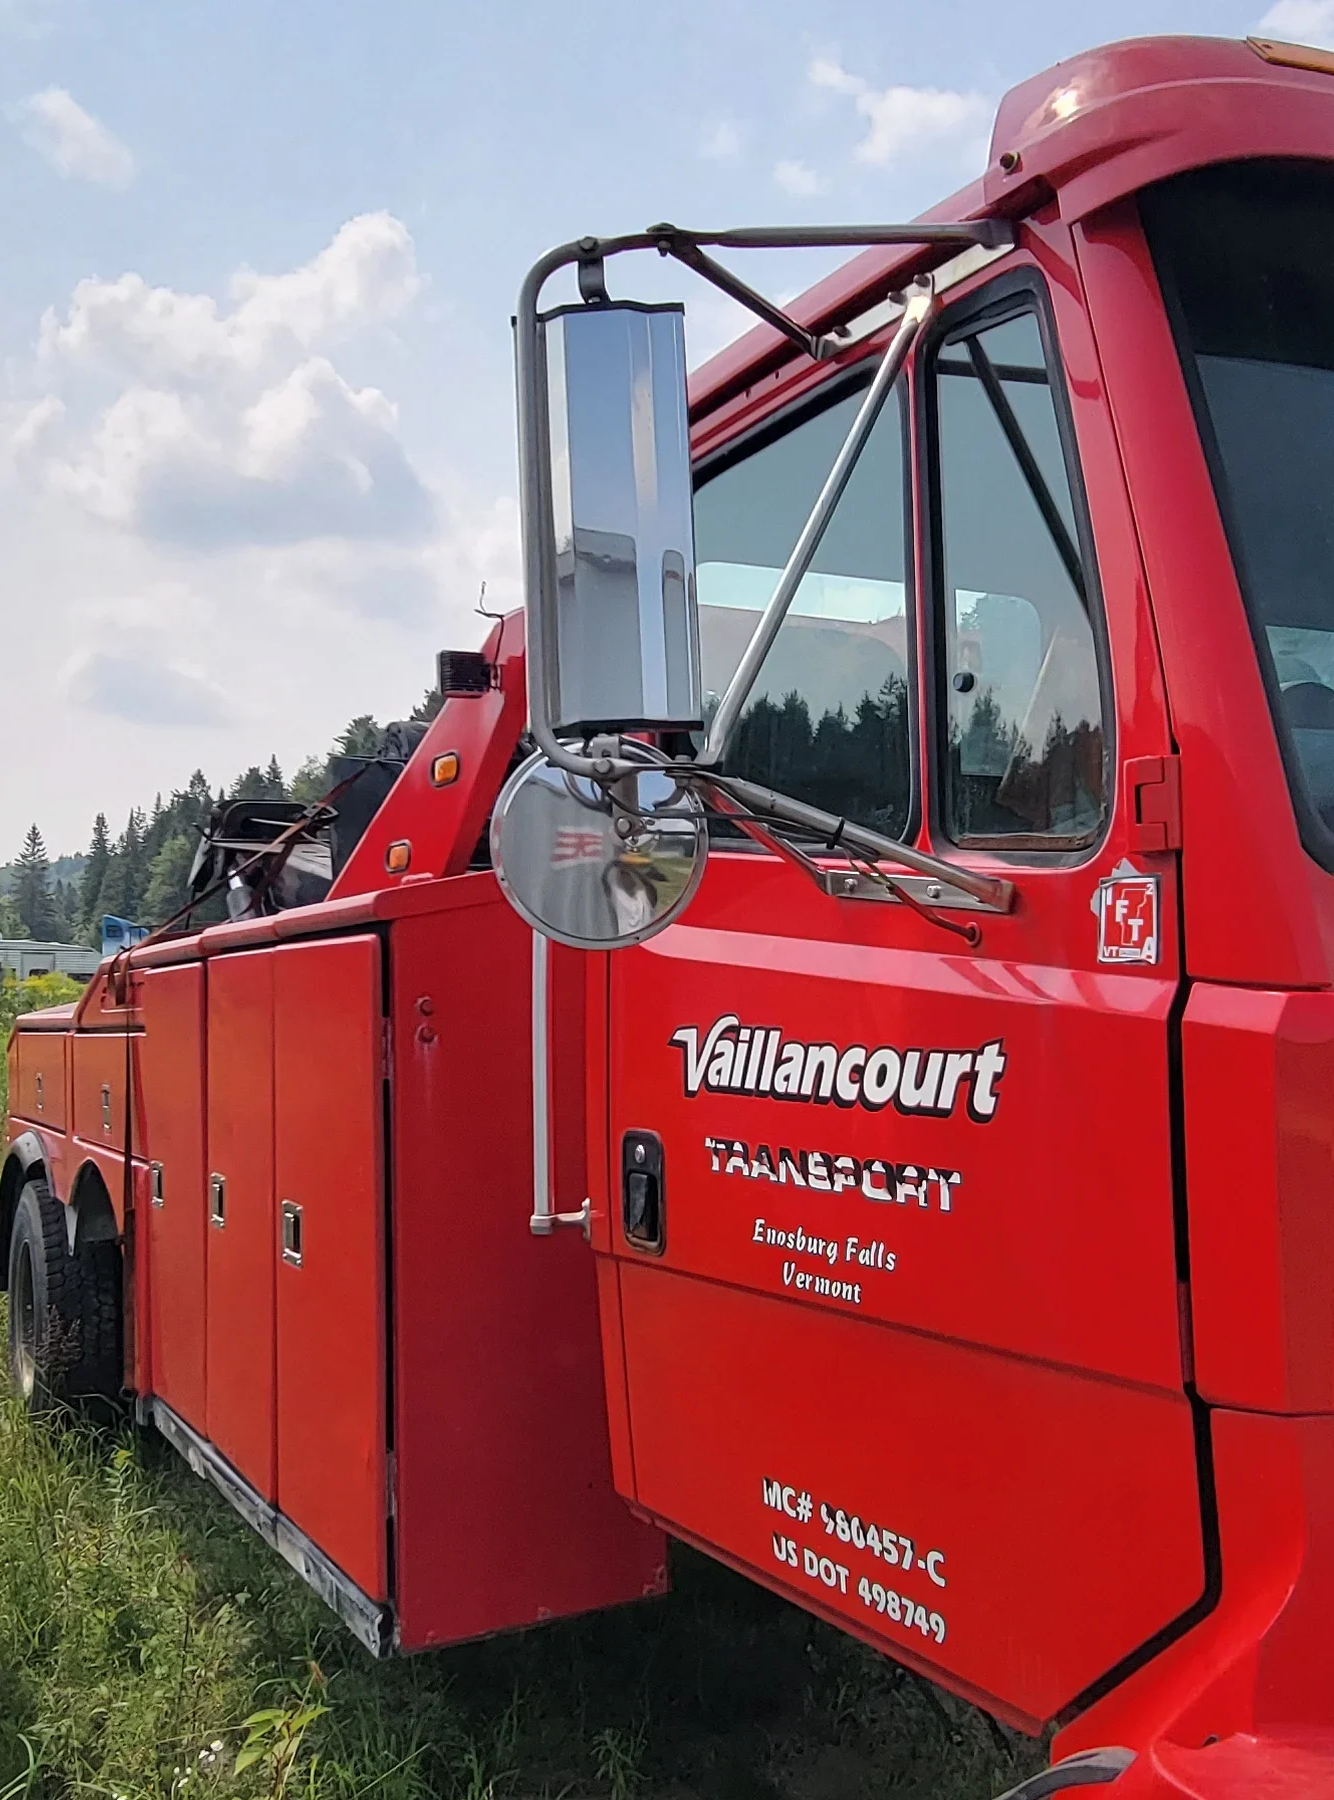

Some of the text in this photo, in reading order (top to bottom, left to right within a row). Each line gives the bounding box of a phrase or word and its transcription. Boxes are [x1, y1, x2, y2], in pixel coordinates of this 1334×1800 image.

[1103, 945, 1120, 957] VT
[668, 1013, 1008, 1122] Vaillancourt
[704, 1136, 962, 1212] TRANSPORT
[752, 1218, 898, 1272] Enosburg Falls
[782, 1261, 862, 1304] Vermont
[762, 1476, 813, 1524] MC#
[772, 1531, 947, 1645] US DOT 498749
